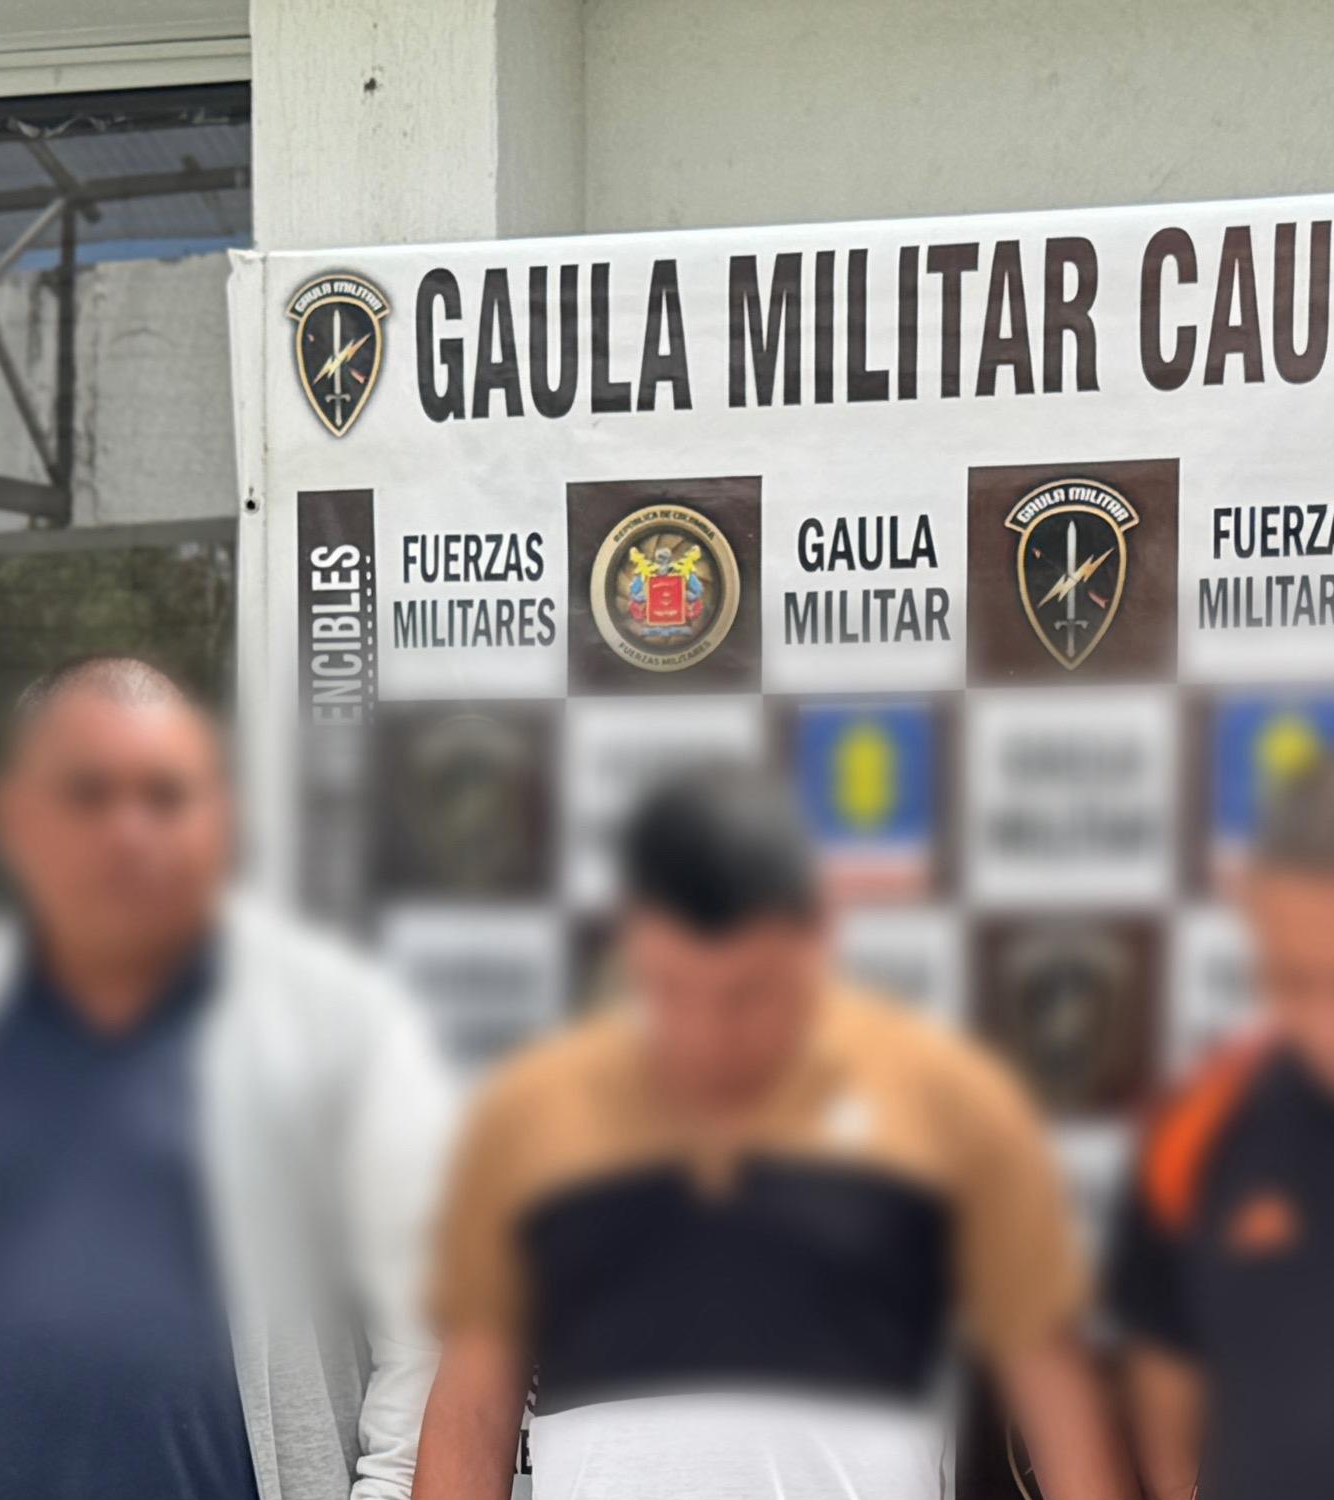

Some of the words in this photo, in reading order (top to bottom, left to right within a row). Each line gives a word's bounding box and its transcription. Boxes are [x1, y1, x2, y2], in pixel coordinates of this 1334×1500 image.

[415, 258, 693, 422] GAULA
[727, 236, 1100, 408] MILITAR
[403, 532, 544, 584] FUERZAS
[798, 514, 938, 573] GAULA
[310, 544, 363, 726] ENCIBLES
[393, 597, 557, 649] MILITARES
[784, 587, 951, 645] MILITAR
